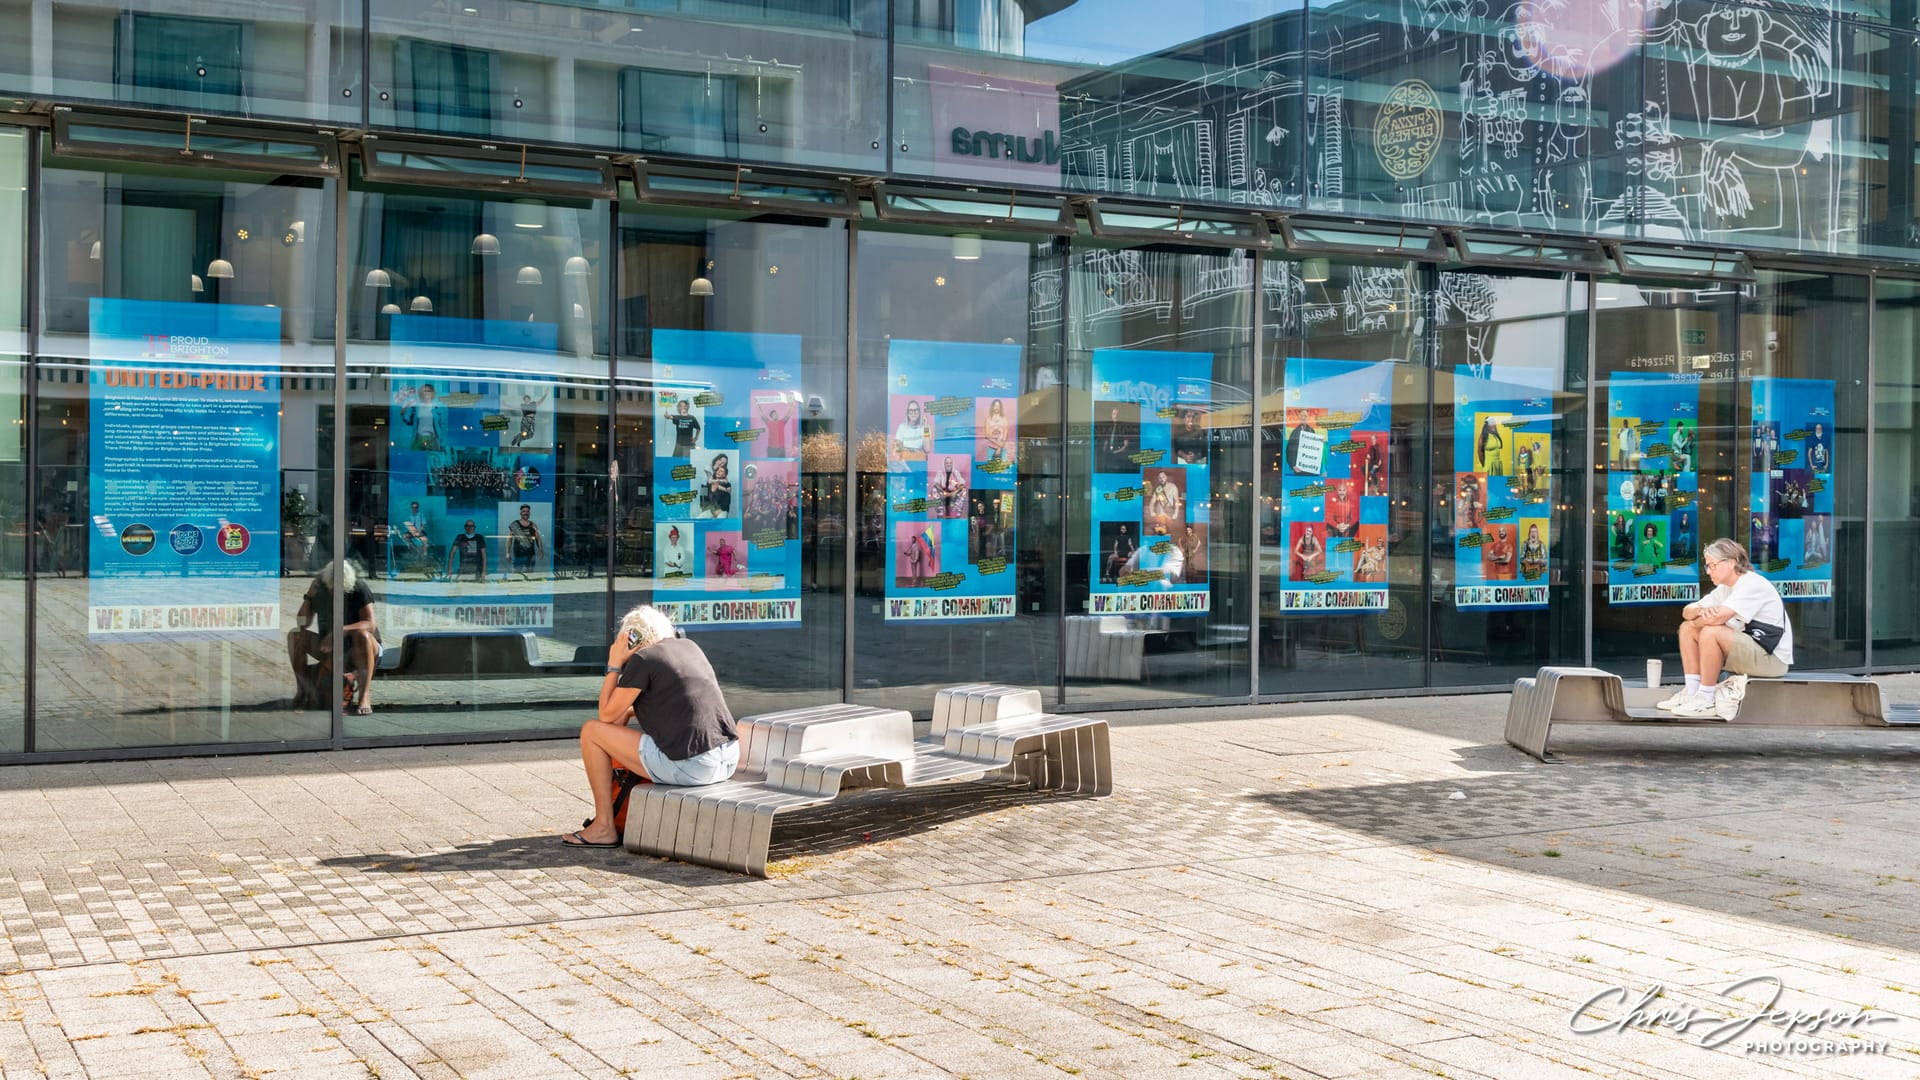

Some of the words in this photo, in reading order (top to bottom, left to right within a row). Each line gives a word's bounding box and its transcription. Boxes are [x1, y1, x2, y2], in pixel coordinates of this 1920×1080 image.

[170, 336, 208, 345] PROUD
[170, 345, 229, 354] BRIGHTON
[105, 368, 188, 388] UNITED
[189, 375, 200, 388] in
[200, 371, 266, 392] PRIDE
[1457, 590, 1469, 603] WE
[1494, 587, 1545, 602] COMMUNITY
[1612, 587, 1623, 600] WE
[1640, 585, 1696, 600] COMMUNITY
[1782, 582, 1828, 596] COMMUNITY
[890, 600, 910, 616] WE
[942, 598, 1012, 616] COMMUNITY
[1094, 595, 1112, 611] WE
[1140, 594, 1206, 610] COMMUNITY
[1284, 592, 1300, 608] WE
[1326, 592, 1385, 607] COMMUNITY
[96, 608, 123, 630] WE
[129, 608, 162, 630] ARE
[168, 606, 272, 628] COMMUNITY
[454, 606, 548, 626] COMMUNITY
[683, 604, 708, 622] ARE
[712, 602, 796, 620] COMMUNITY
